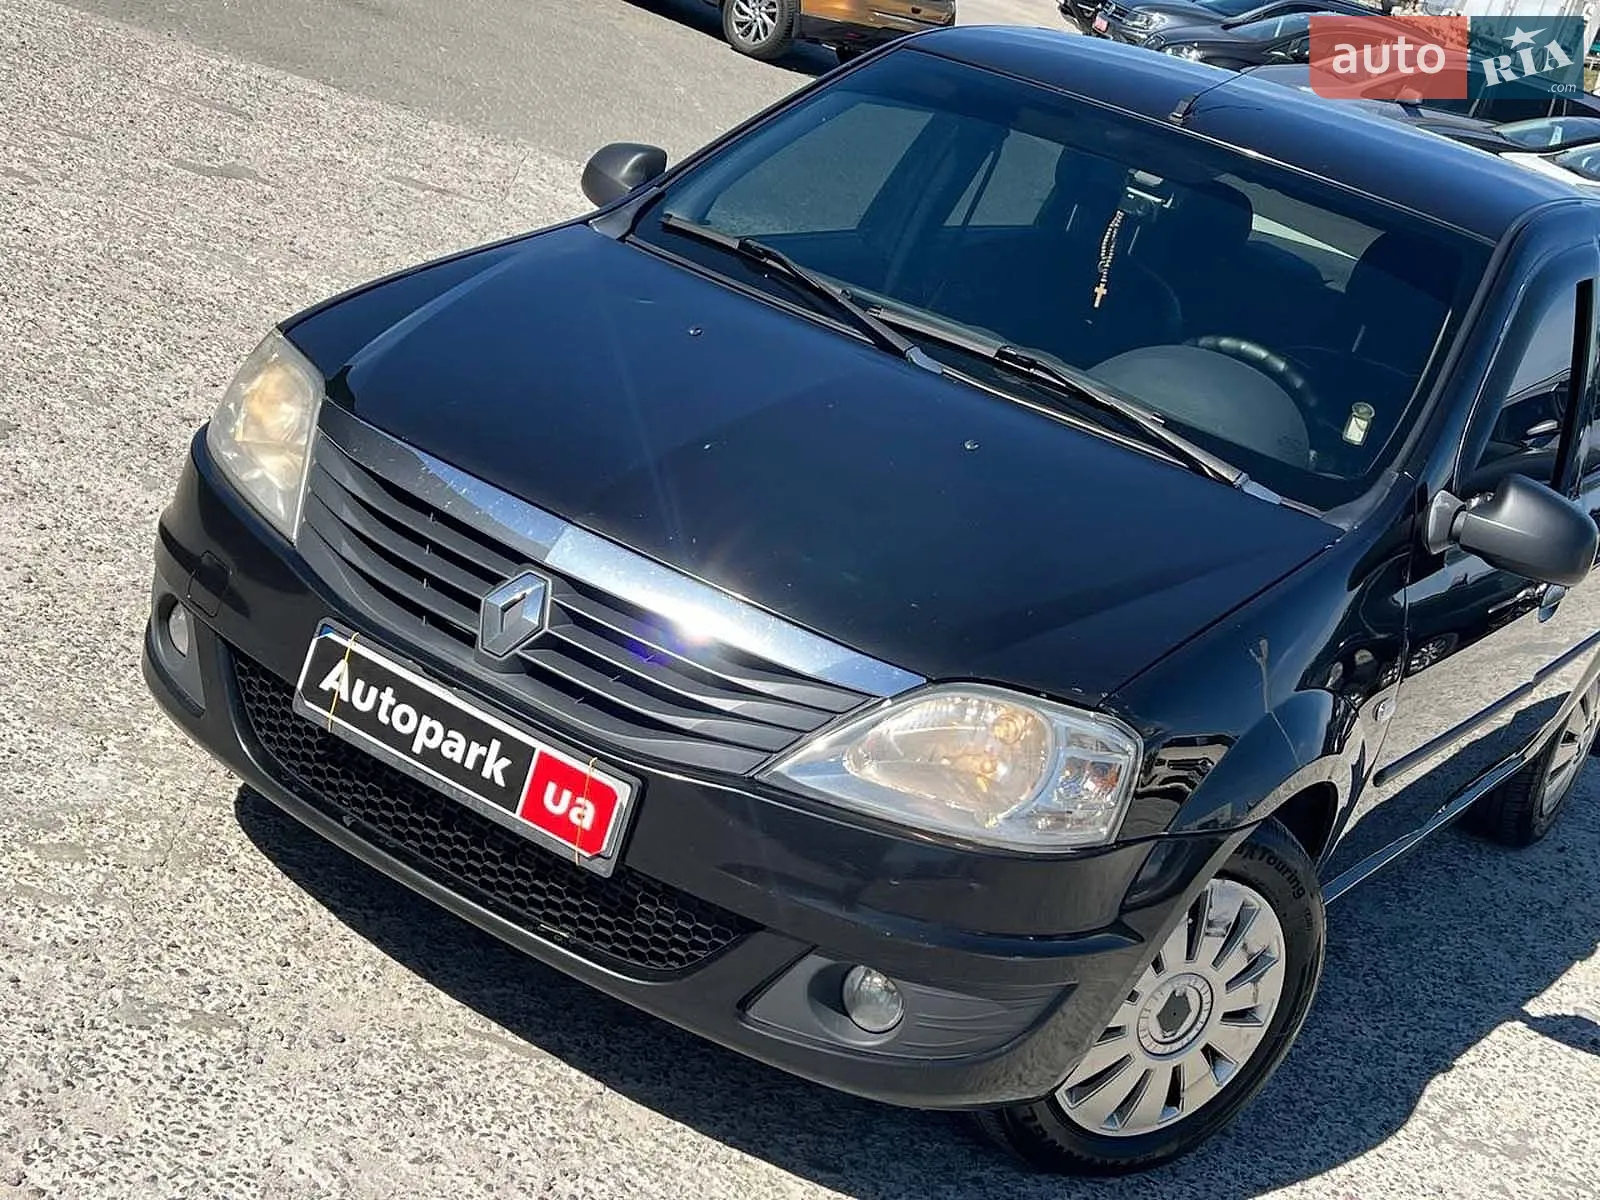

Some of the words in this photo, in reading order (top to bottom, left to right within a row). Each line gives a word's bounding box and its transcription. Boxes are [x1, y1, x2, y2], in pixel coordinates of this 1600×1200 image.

[319, 660, 514, 788] Autopark
[543, 781, 596, 830] ua
[1258, 846, 1306, 900] Touring
